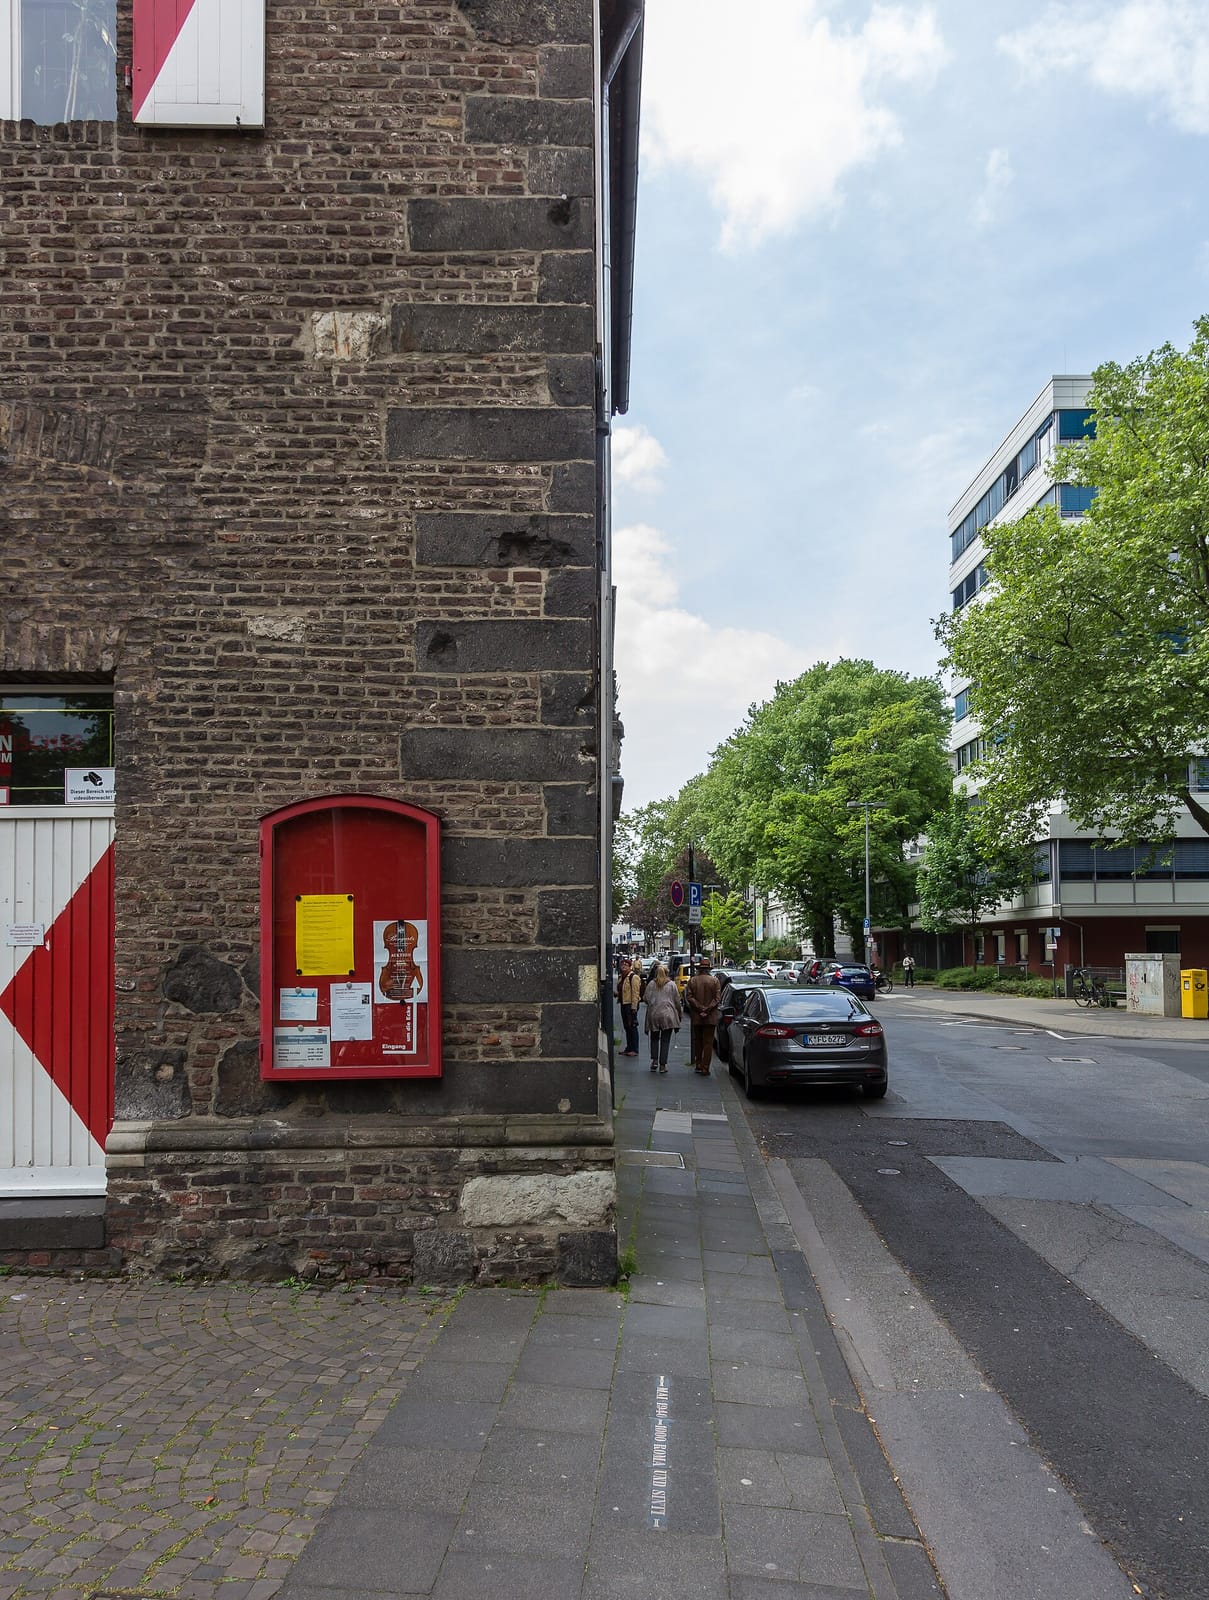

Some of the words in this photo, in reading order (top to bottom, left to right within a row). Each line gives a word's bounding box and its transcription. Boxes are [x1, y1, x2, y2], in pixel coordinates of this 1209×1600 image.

[691, 886, 698, 905] P
[656, 1386, 669, 1400] MAI
[655, 1402, 668, 1418] 1940
[654, 1424, 668, 1442] 1000
[653, 1443, 667, 1467] ROMA
[652, 1470, 667, 1487] UND
[651, 1489, 666, 1516] SINTI
